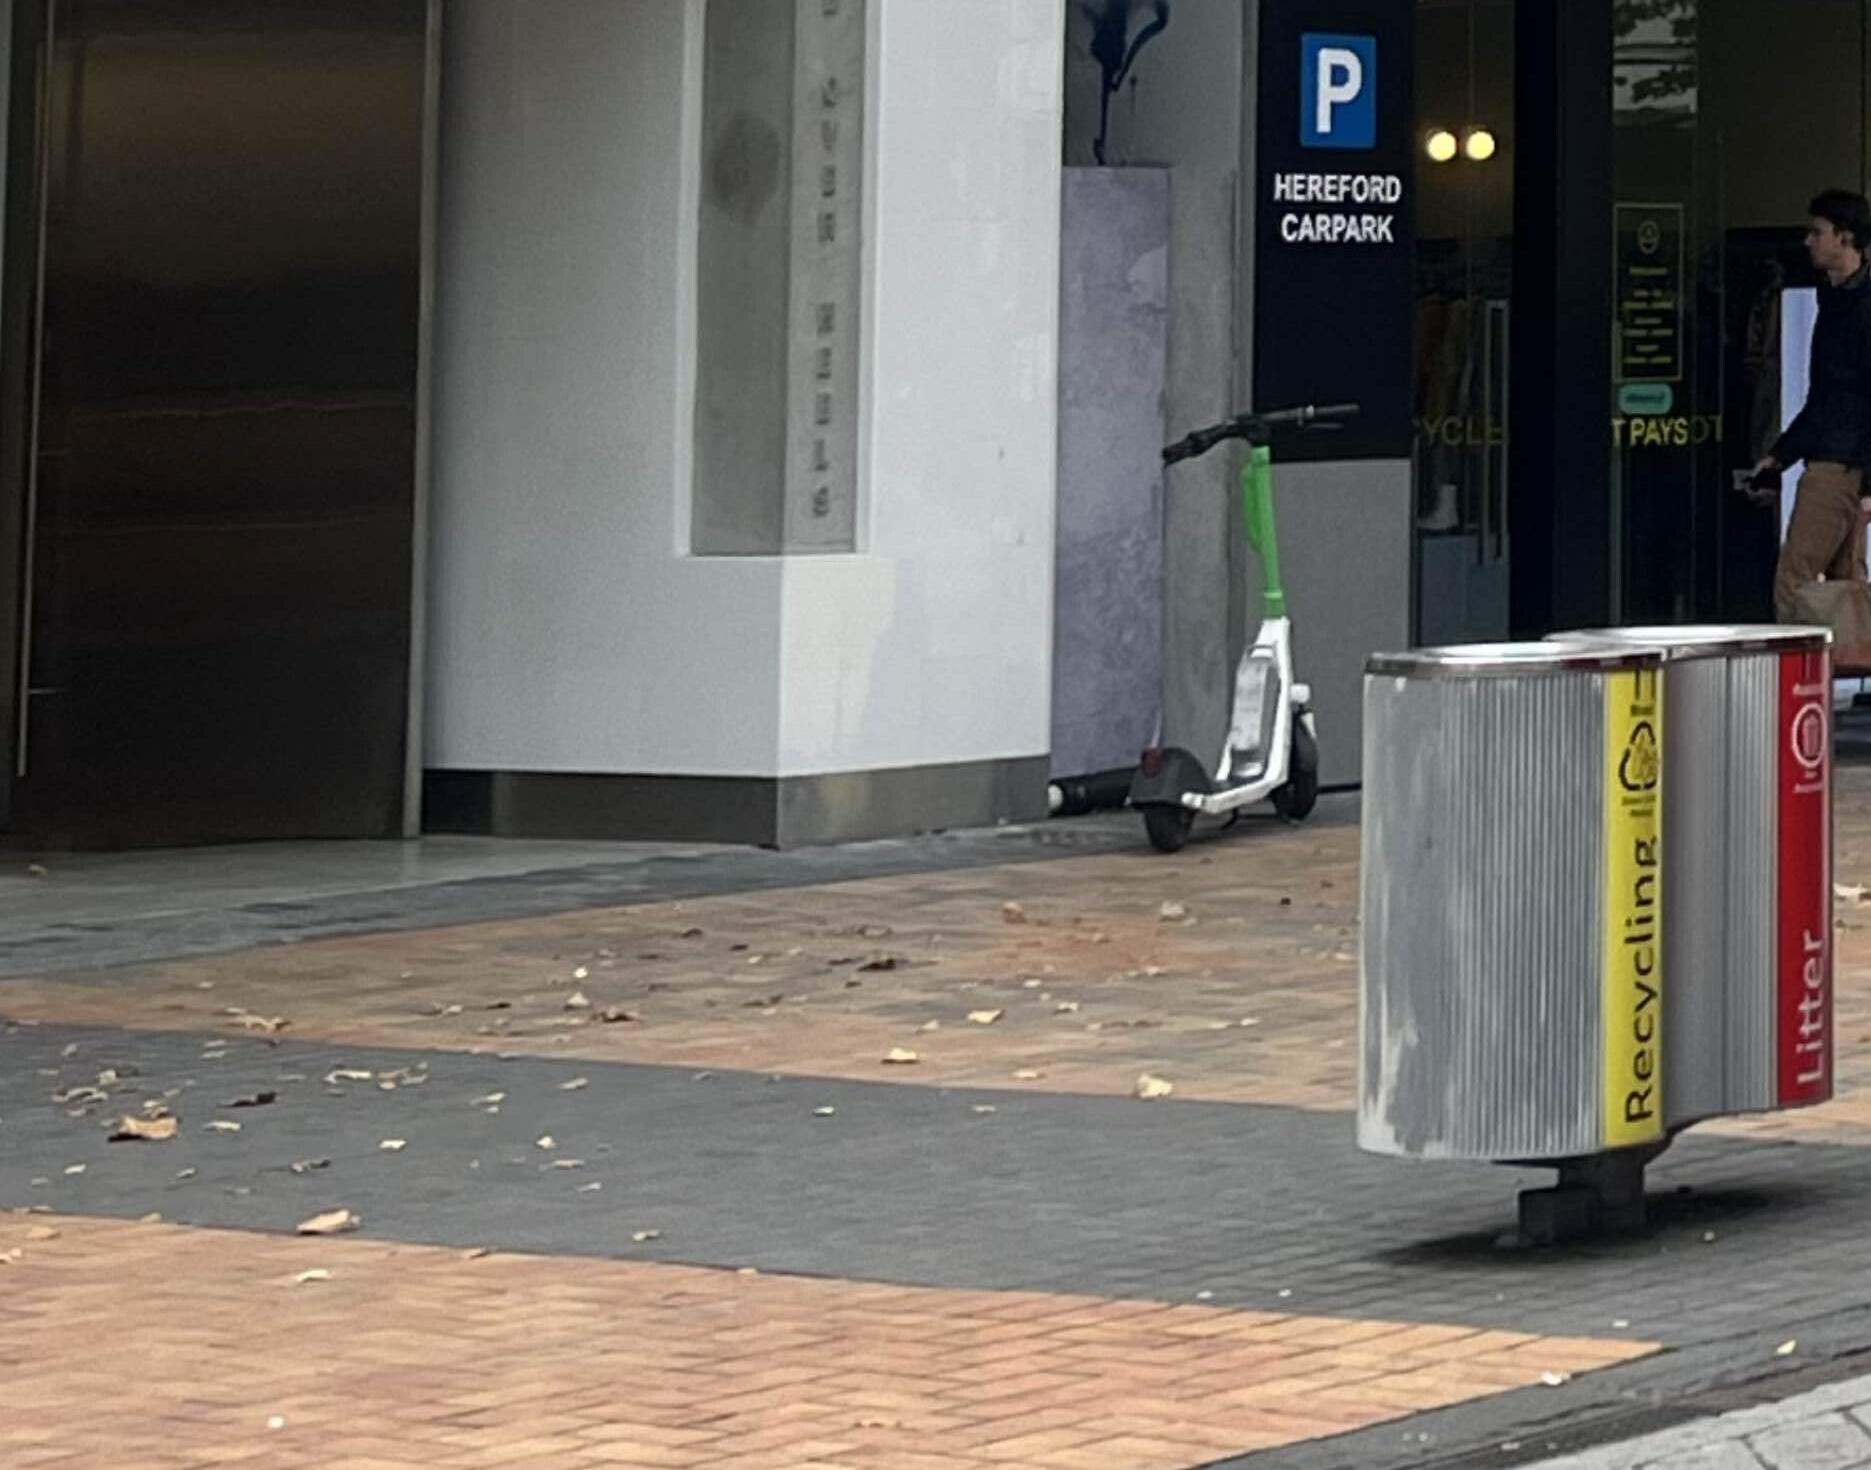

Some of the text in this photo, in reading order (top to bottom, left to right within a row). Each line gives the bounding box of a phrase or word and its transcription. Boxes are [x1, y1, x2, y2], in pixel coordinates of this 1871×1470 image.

[1316, 48, 1362, 133] P
[1274, 173, 1401, 203] HEREFORD
[1281, 213, 1394, 243] CARPARK
[1630, 417, 1688, 445] PAYS
[1624, 836, 1658, 1123] Recycling
[1796, 930, 1826, 1085] Litter
